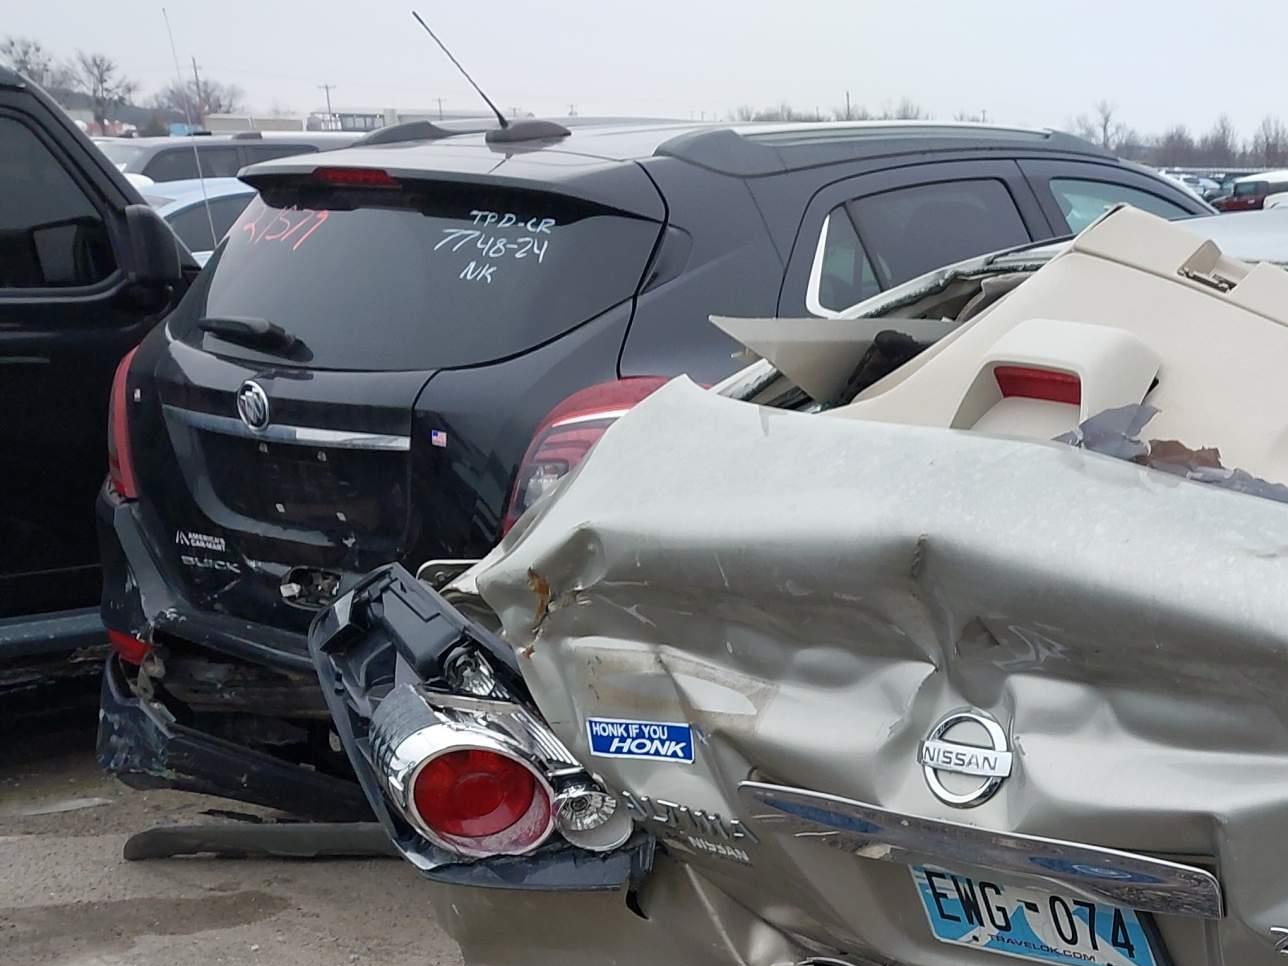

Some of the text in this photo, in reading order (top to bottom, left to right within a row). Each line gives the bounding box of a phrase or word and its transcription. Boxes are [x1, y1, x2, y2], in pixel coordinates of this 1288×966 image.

[469, 209, 556, 234] TPD-CR
[434, 227, 549, 263] 7748-24
[459, 261, 498, 284] NK
[181, 555, 241, 574] BUICK
[592, 722, 668, 739] HONK IF YOU
[609, 738, 687, 757] HONK
[923, 746, 998, 771] NISSAN
[687, 835, 750, 862] NISSAN
[987, 933, 1096, 962] TRAVELOK.COM
